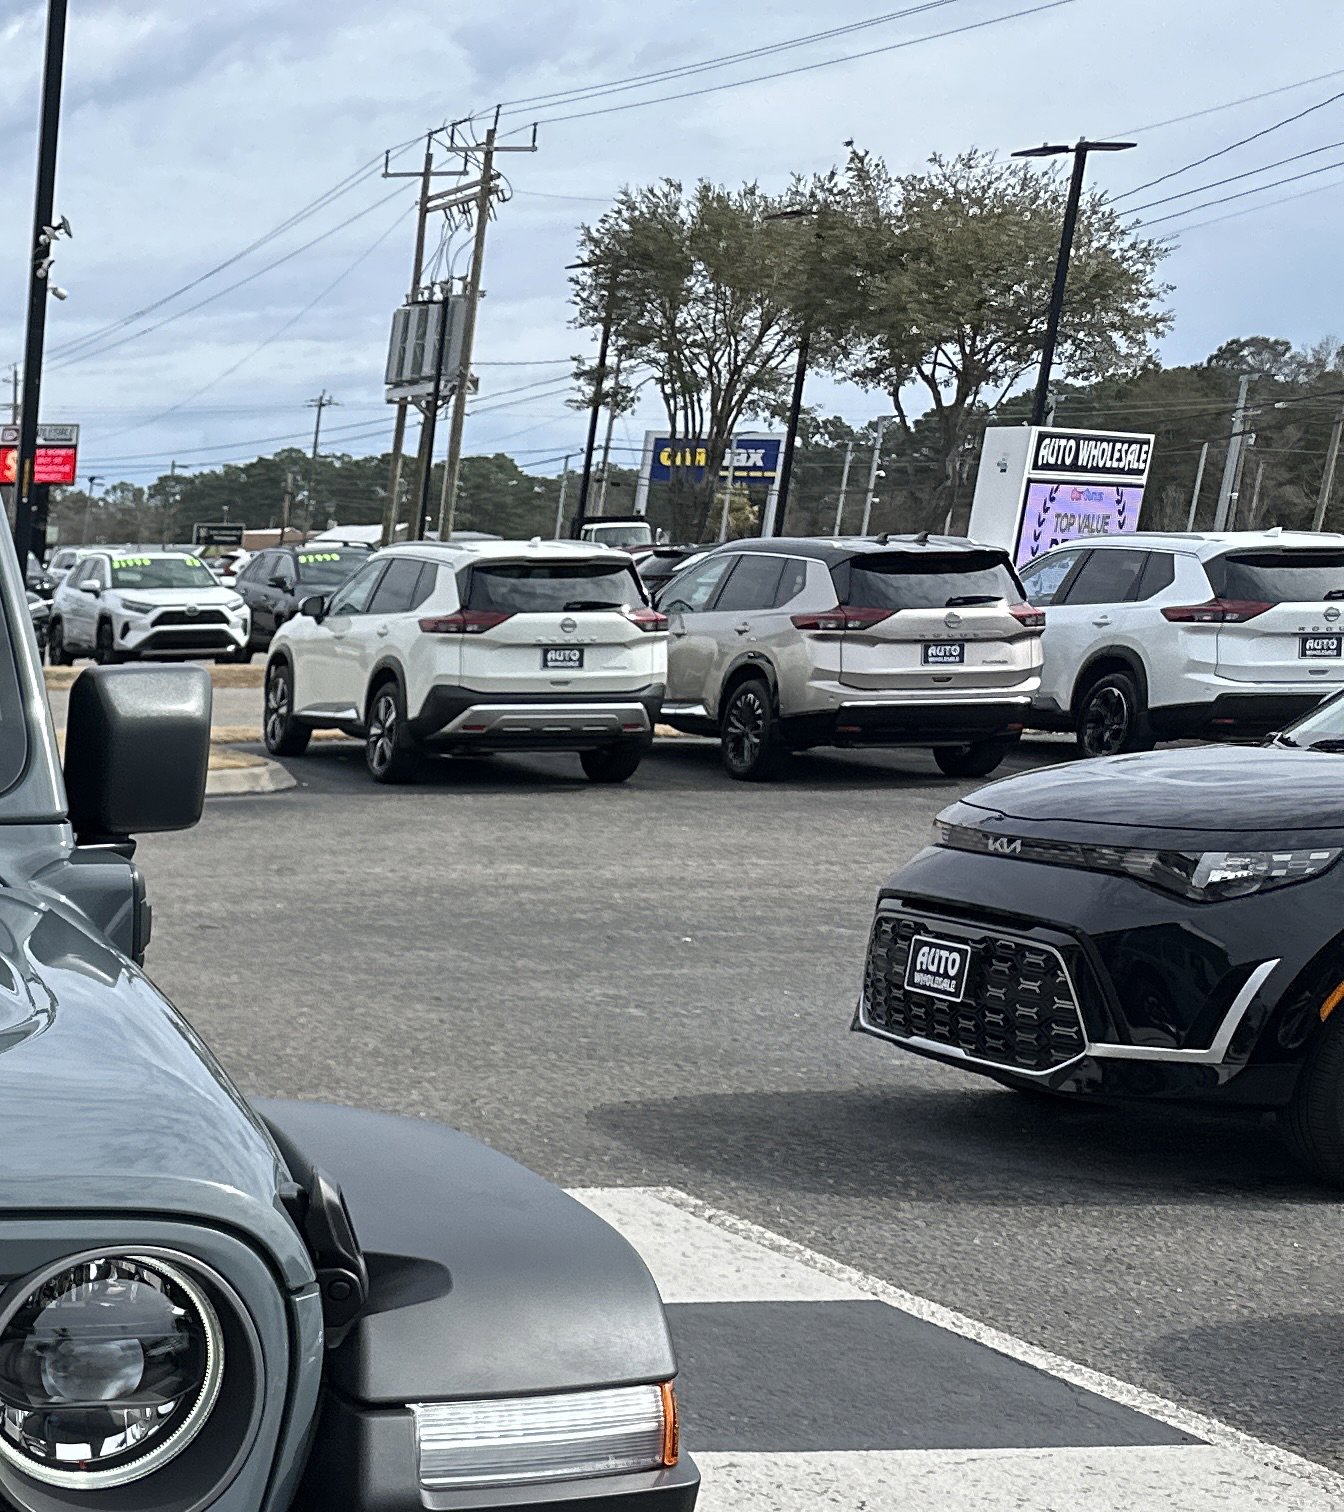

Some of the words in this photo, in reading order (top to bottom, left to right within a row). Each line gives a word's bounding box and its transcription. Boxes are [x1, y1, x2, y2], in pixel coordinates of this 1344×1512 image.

[1037, 438, 1076, 467] AUTO
[1078, 440, 1149, 471] WHOLESALE
[1054, 513, 1076, 534] TOP
[1077, 513, 1111, 534] VALUE
[928, 645, 960, 656] AUTO
[1305, 639, 1337, 650] AUTO
[547, 650, 580, 661] AUTO
[916, 946, 961, 977] AUTO
[913, 971, 957, 993] WHOLESALE
